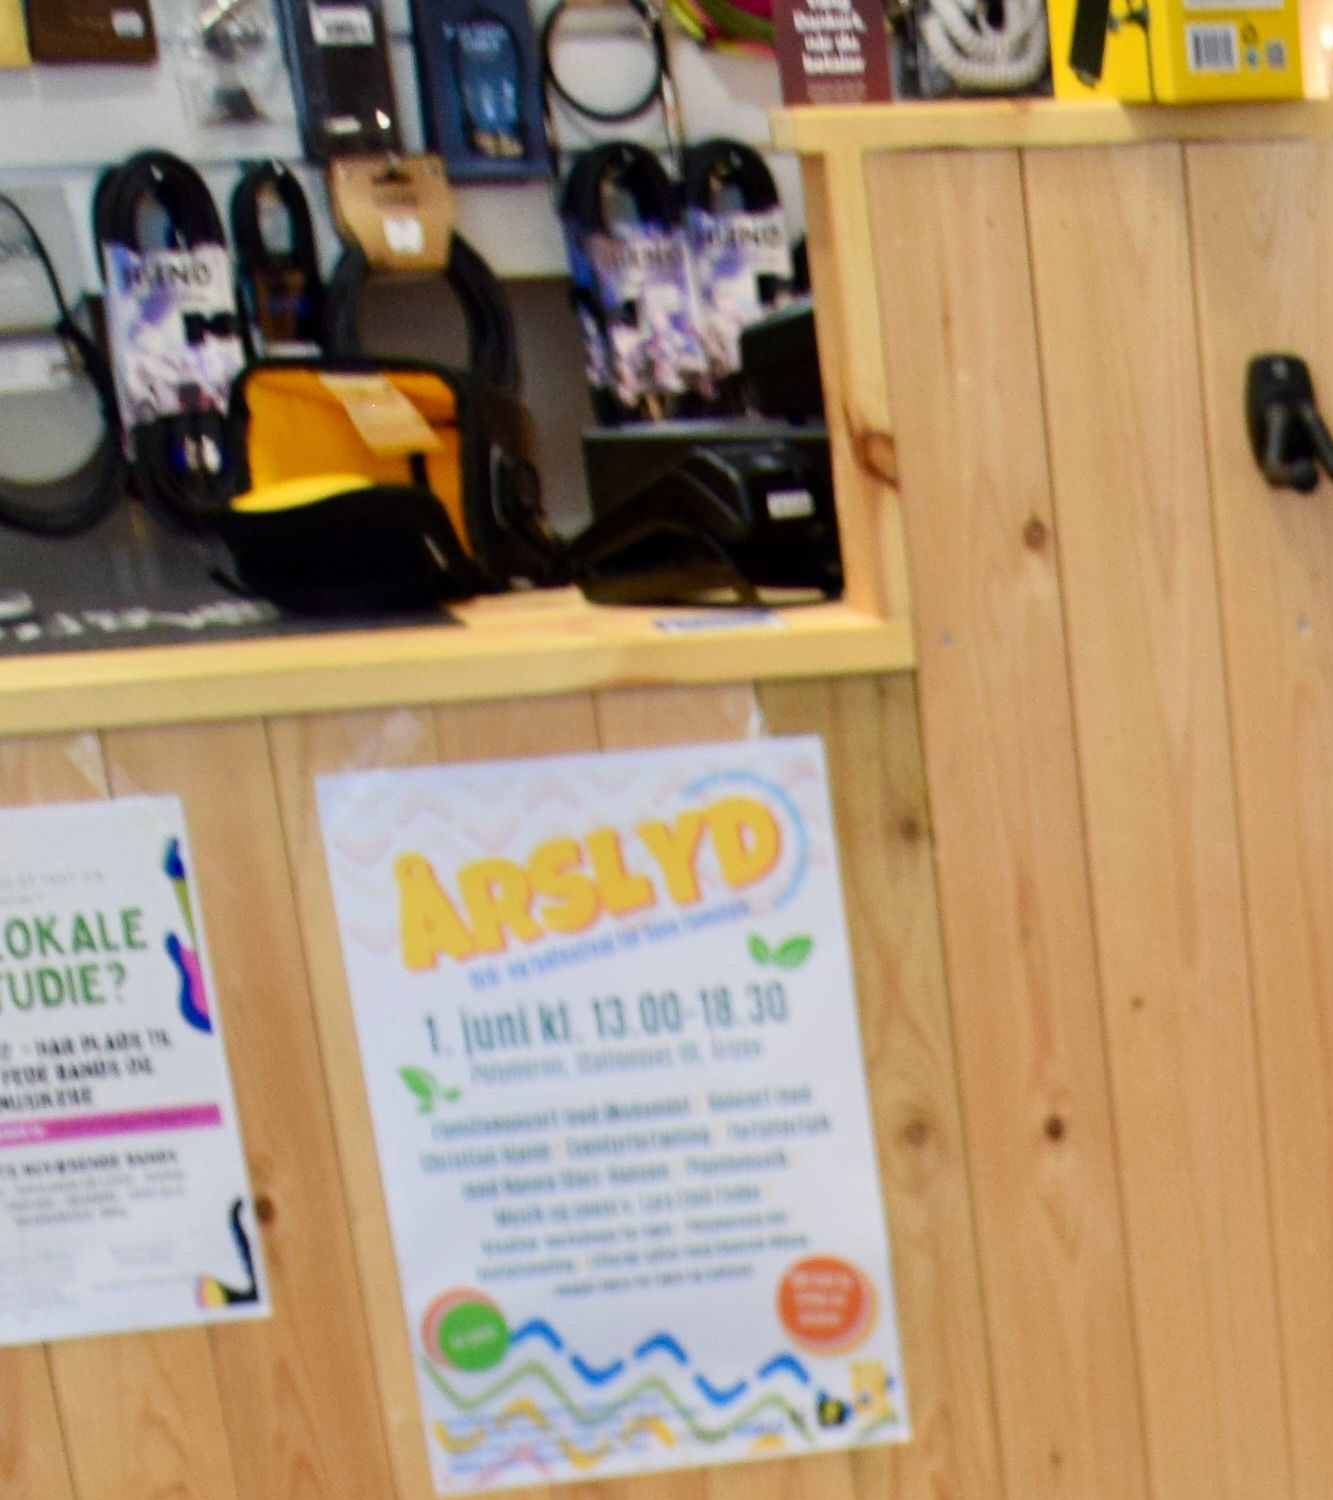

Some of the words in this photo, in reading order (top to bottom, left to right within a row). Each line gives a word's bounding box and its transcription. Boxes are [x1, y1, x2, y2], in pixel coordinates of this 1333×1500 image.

[393, 794, 783, 975] ÅRSLYD
[0, 906, 147, 960] OKALE
[0, 961, 126, 1012] UDIE?
[459, 1000, 529, 1060] juni
